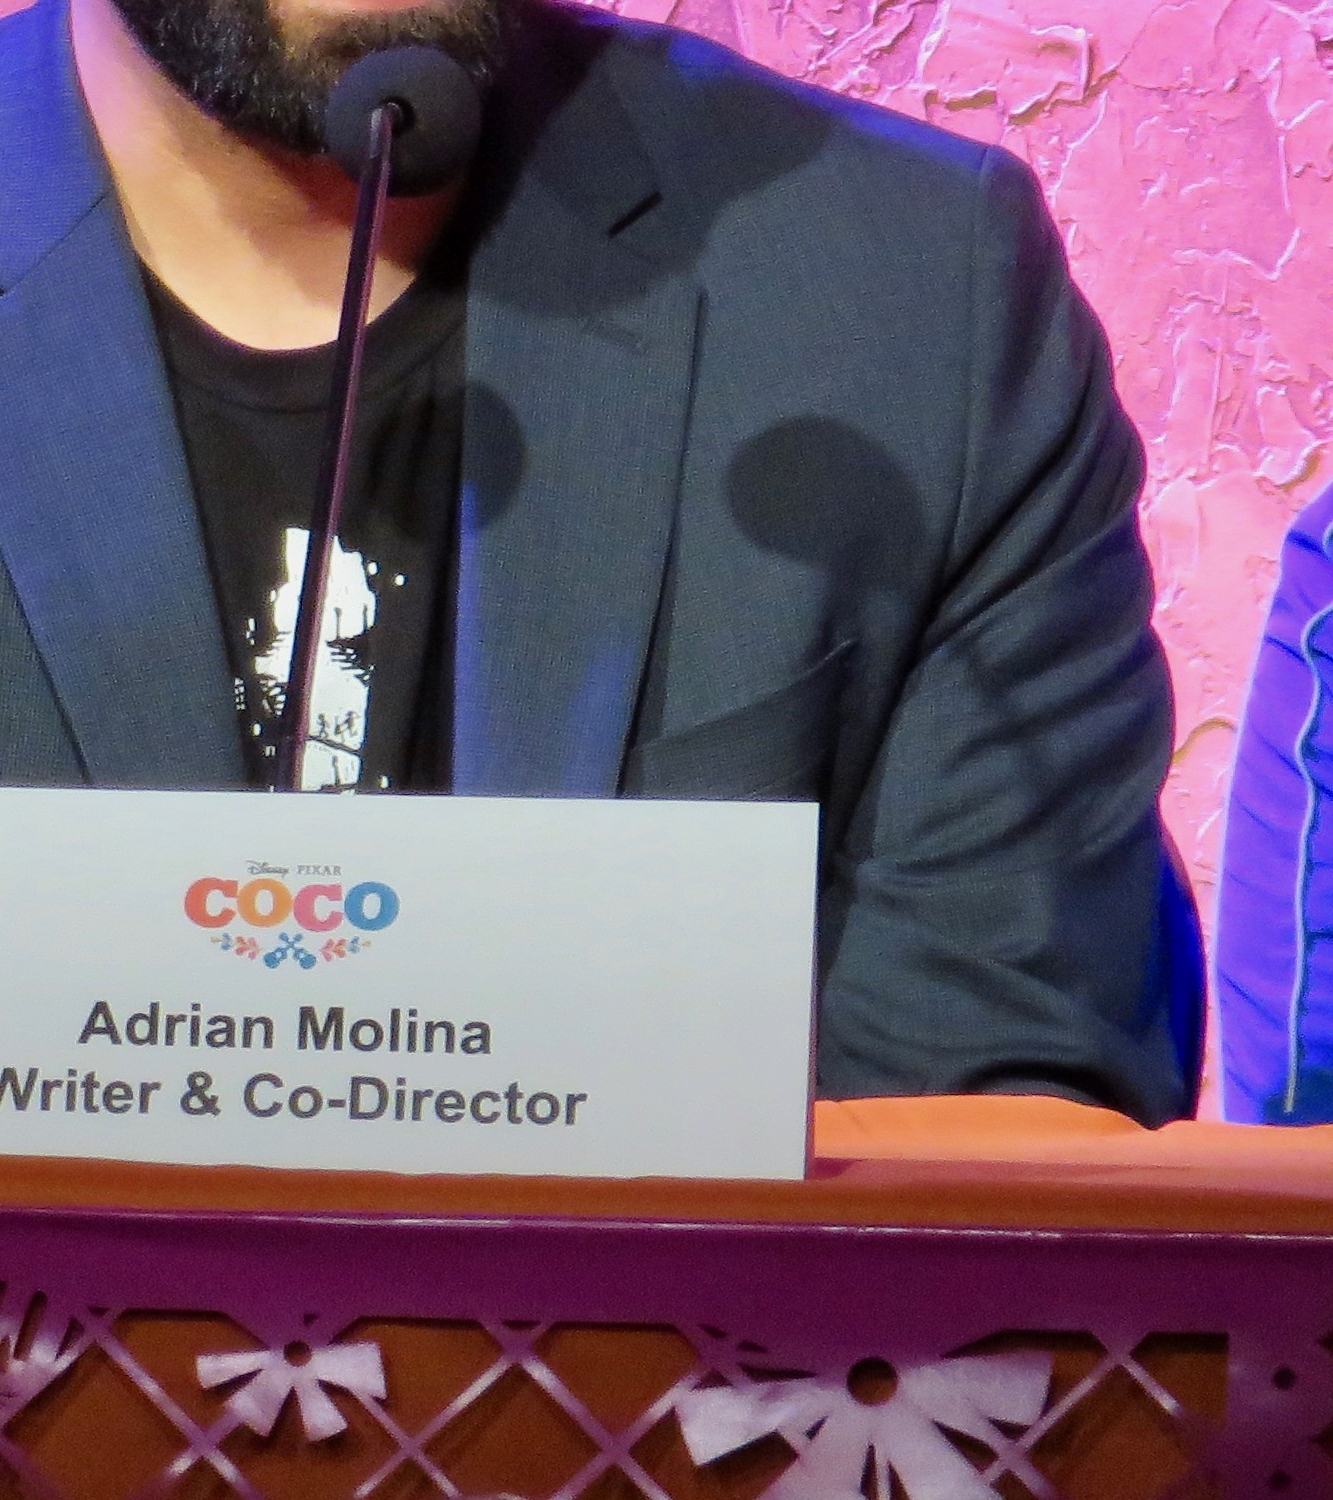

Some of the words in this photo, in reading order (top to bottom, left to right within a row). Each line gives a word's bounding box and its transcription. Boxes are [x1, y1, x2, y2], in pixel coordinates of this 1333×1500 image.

[245, 859, 290, 878] Disney
[297, 864, 342, 876] PIXAR
[184, 876, 401, 932] COCO
[77, 1000, 276, 1049] Adrian
[297, 1005, 493, 1056] Molina
[179, 1070, 222, 1117] &
[243, 1072, 589, 1126] Co-Director
